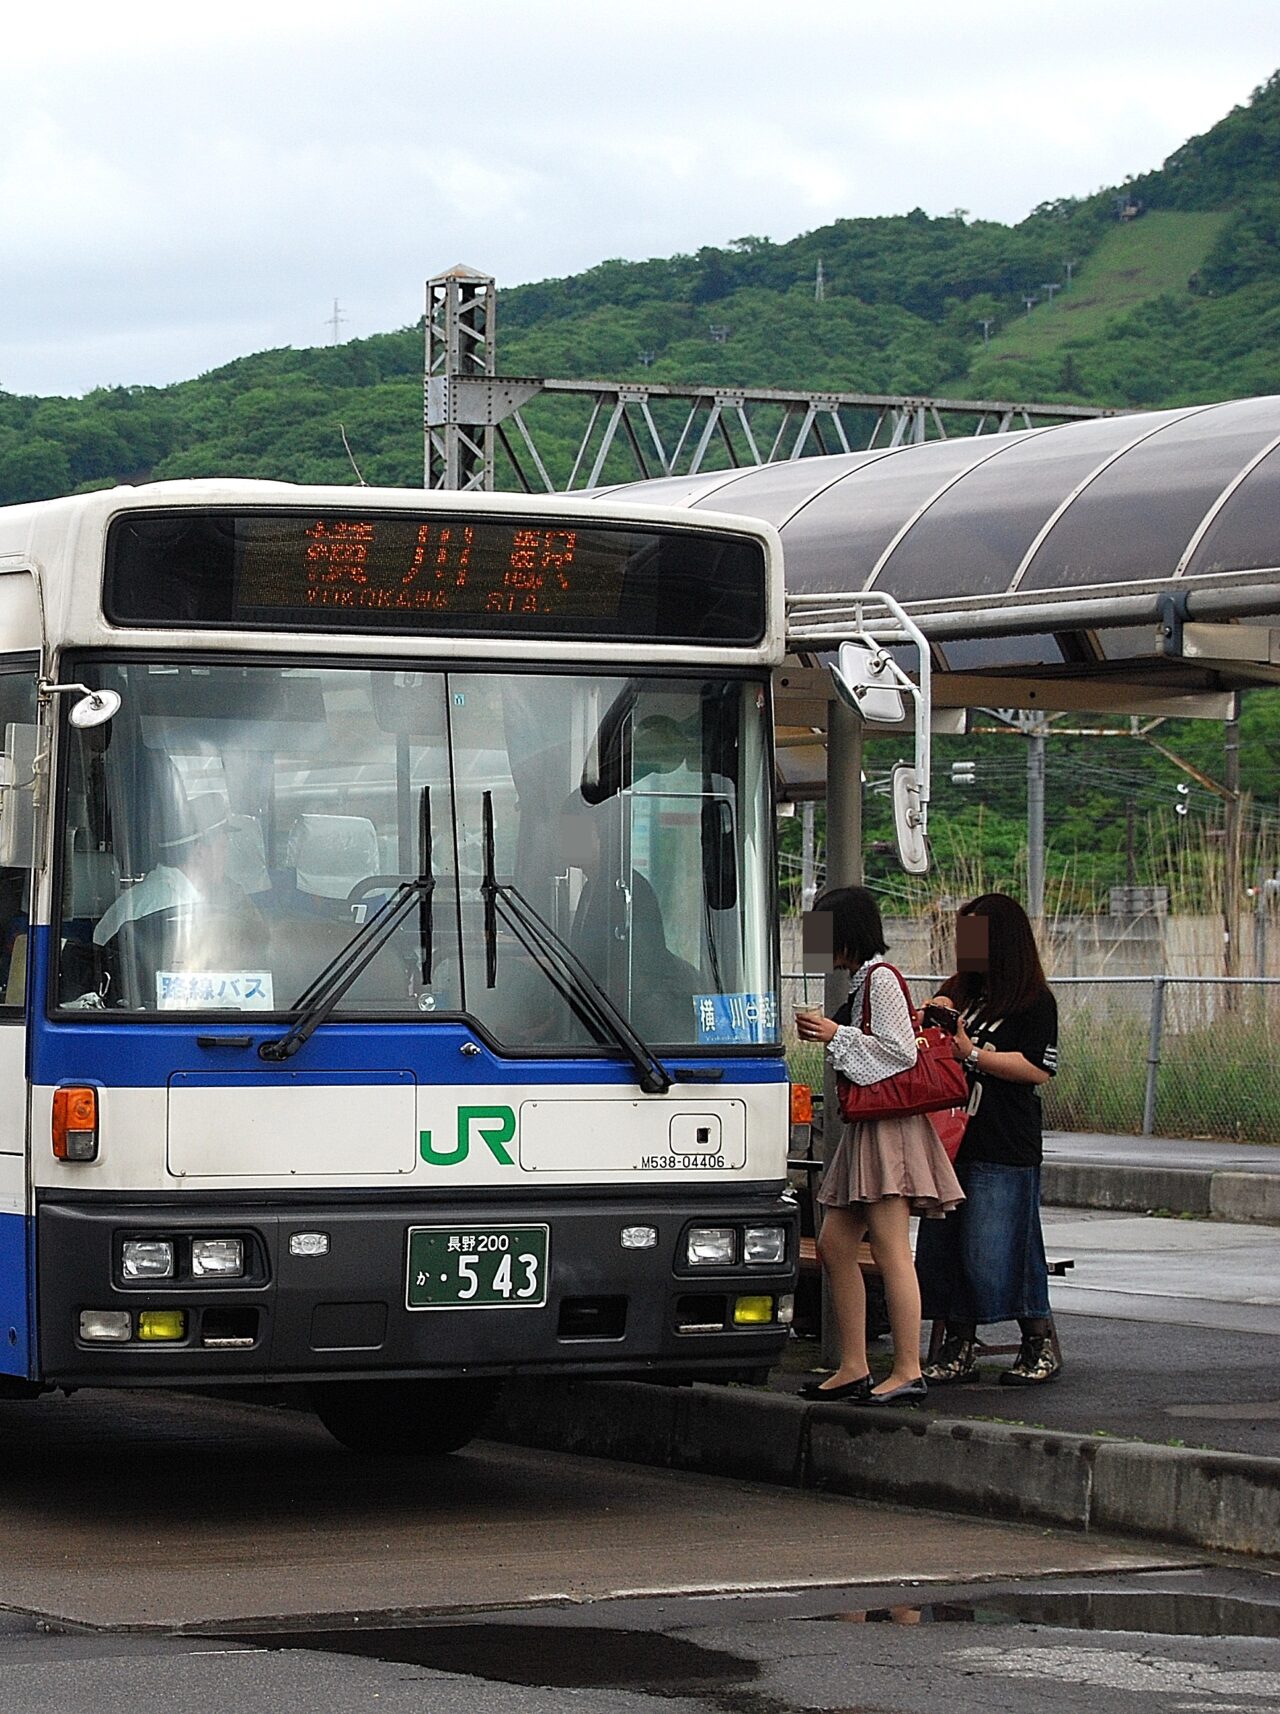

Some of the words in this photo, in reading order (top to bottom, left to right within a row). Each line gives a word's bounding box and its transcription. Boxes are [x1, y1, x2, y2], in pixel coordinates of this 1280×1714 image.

[161, 976, 266, 1001] 路線バス
[419, 1105, 516, 1166] JR
[641, 1154, 725, 1169] M538-04406
[416, 1270, 430, 1286] か
